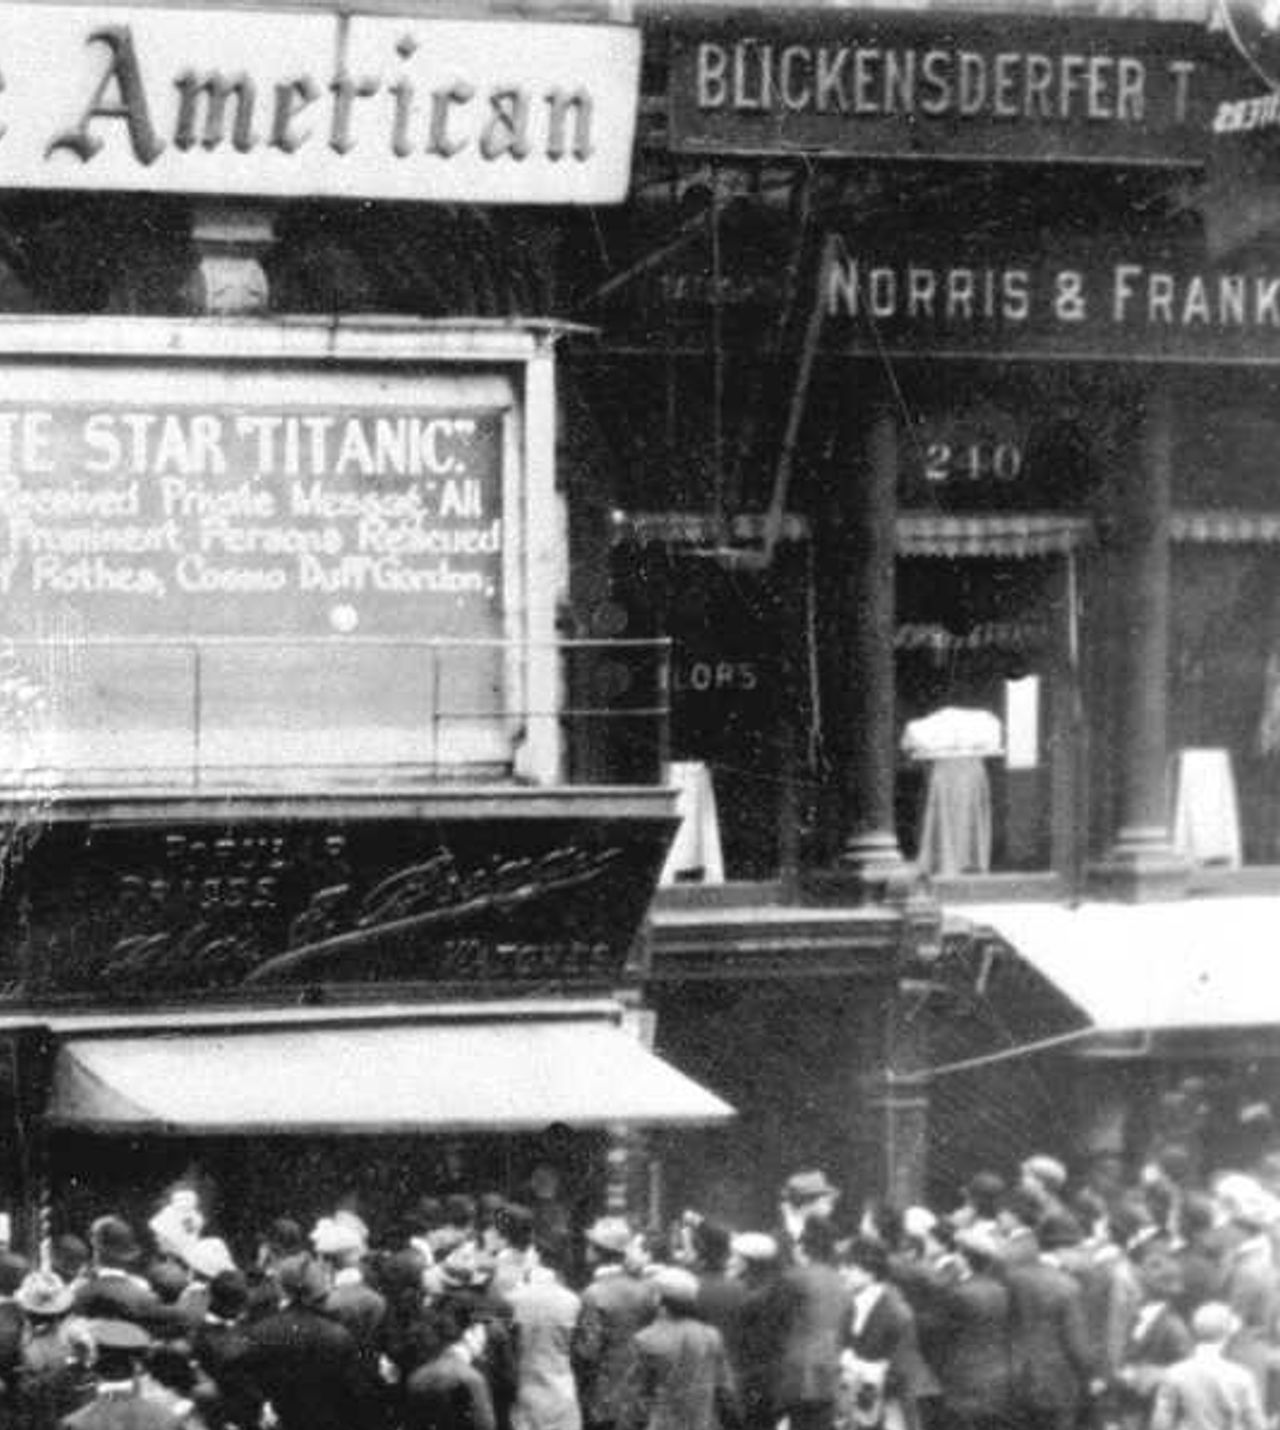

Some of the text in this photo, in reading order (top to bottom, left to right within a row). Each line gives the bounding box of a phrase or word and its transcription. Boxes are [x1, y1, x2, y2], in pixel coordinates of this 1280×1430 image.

[42, 22, 596, 168] American
[827, 256, 1030, 321] NORRIS
[1054, 270, 1087, 322] &
[84, 412, 227, 475] STAR
